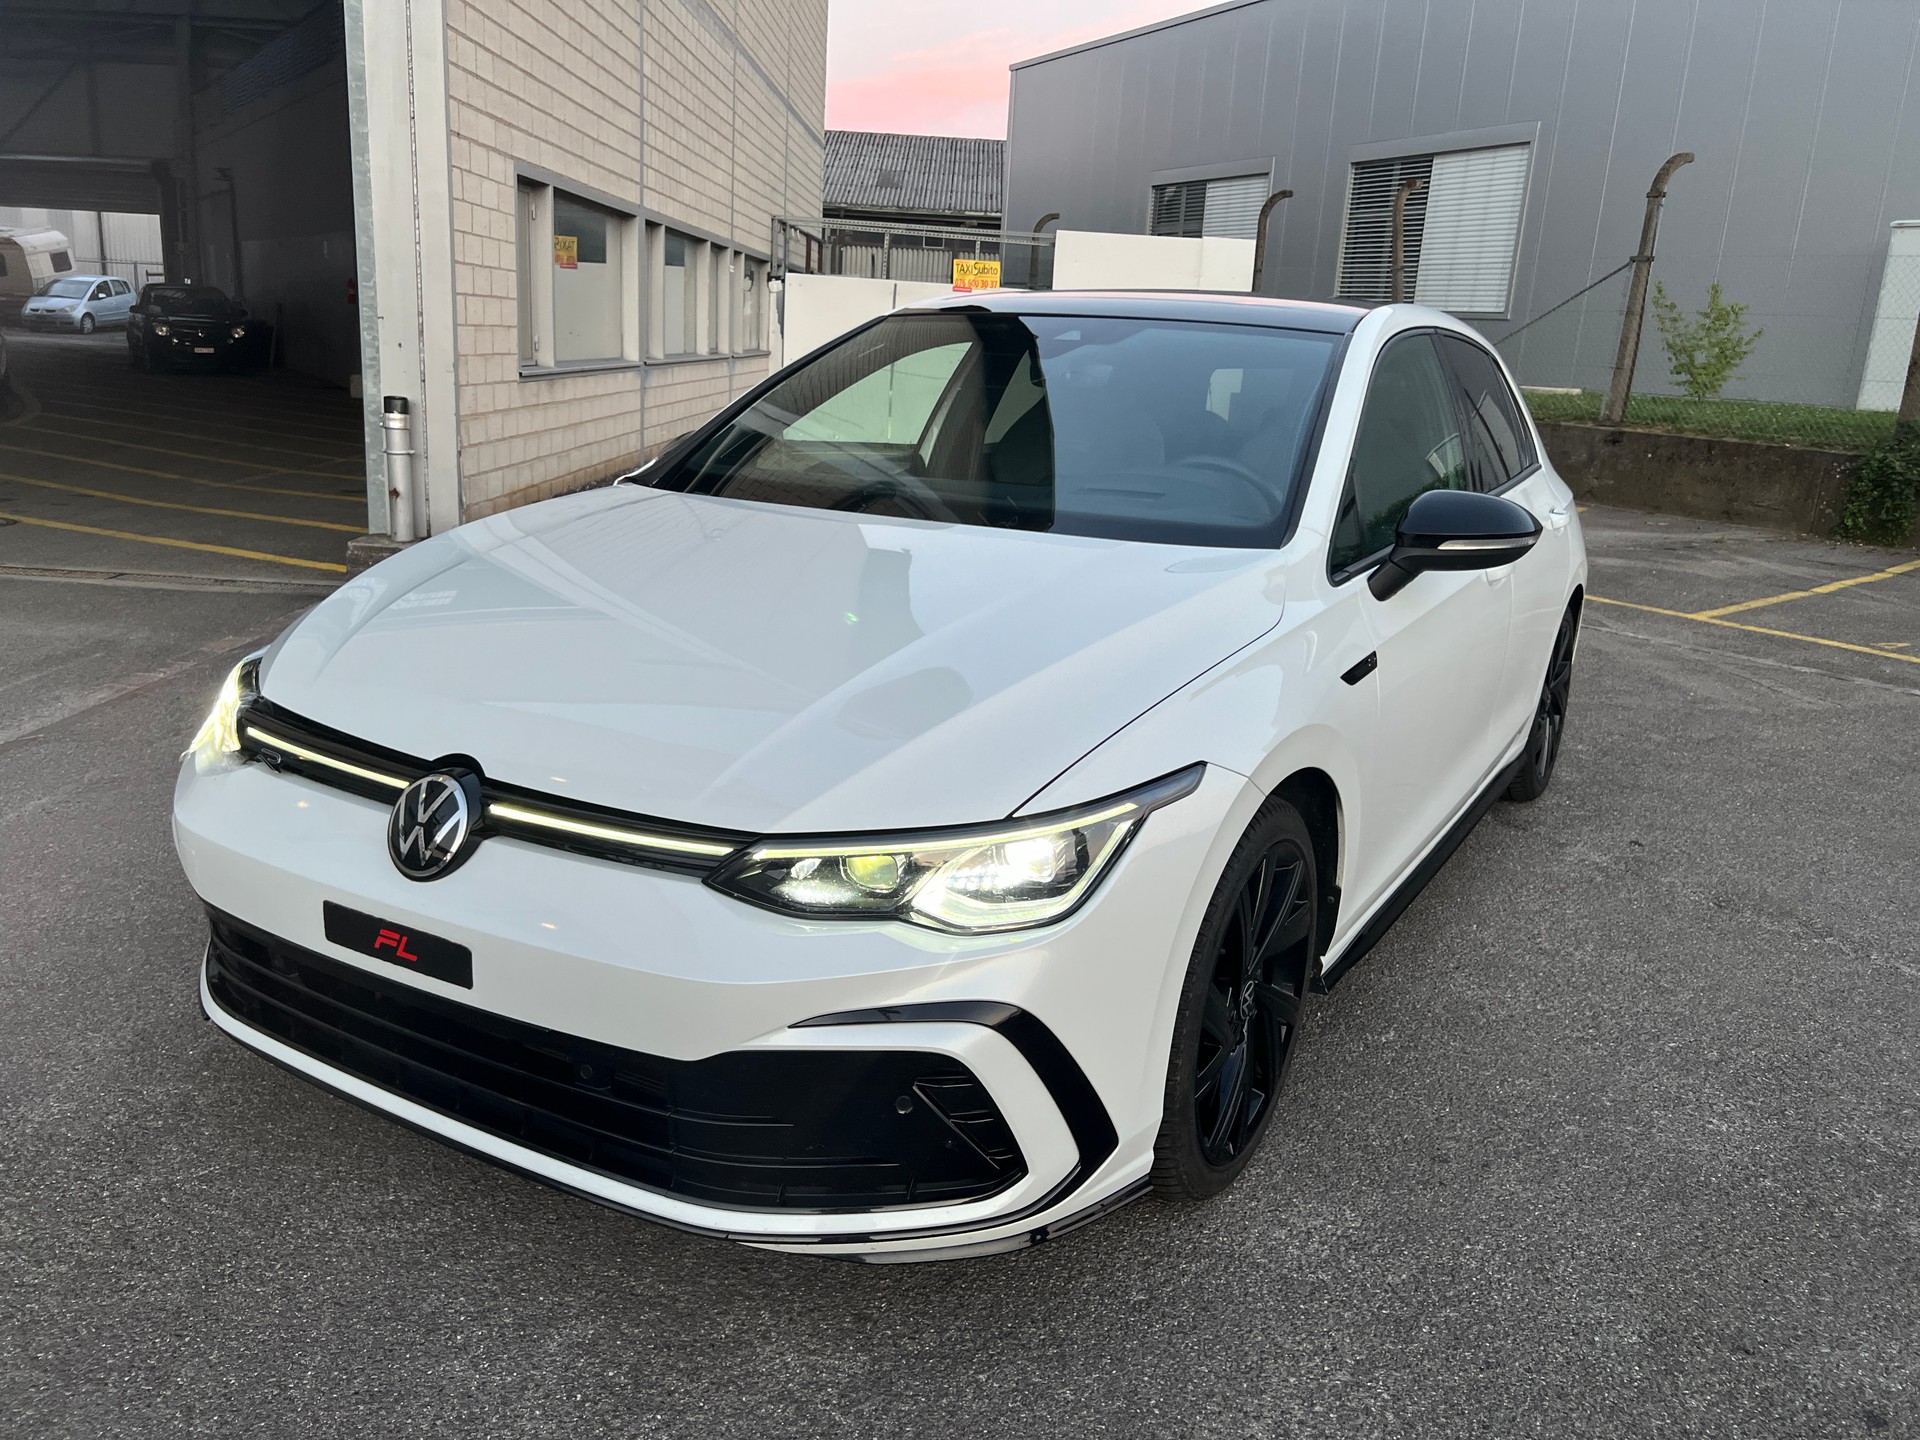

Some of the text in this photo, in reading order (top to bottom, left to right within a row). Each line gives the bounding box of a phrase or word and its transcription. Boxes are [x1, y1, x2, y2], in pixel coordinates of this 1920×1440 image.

[955, 262, 998, 275] TAXI Subito
[390, 775, 467, 874] VW
[374, 928, 418, 962] FL
